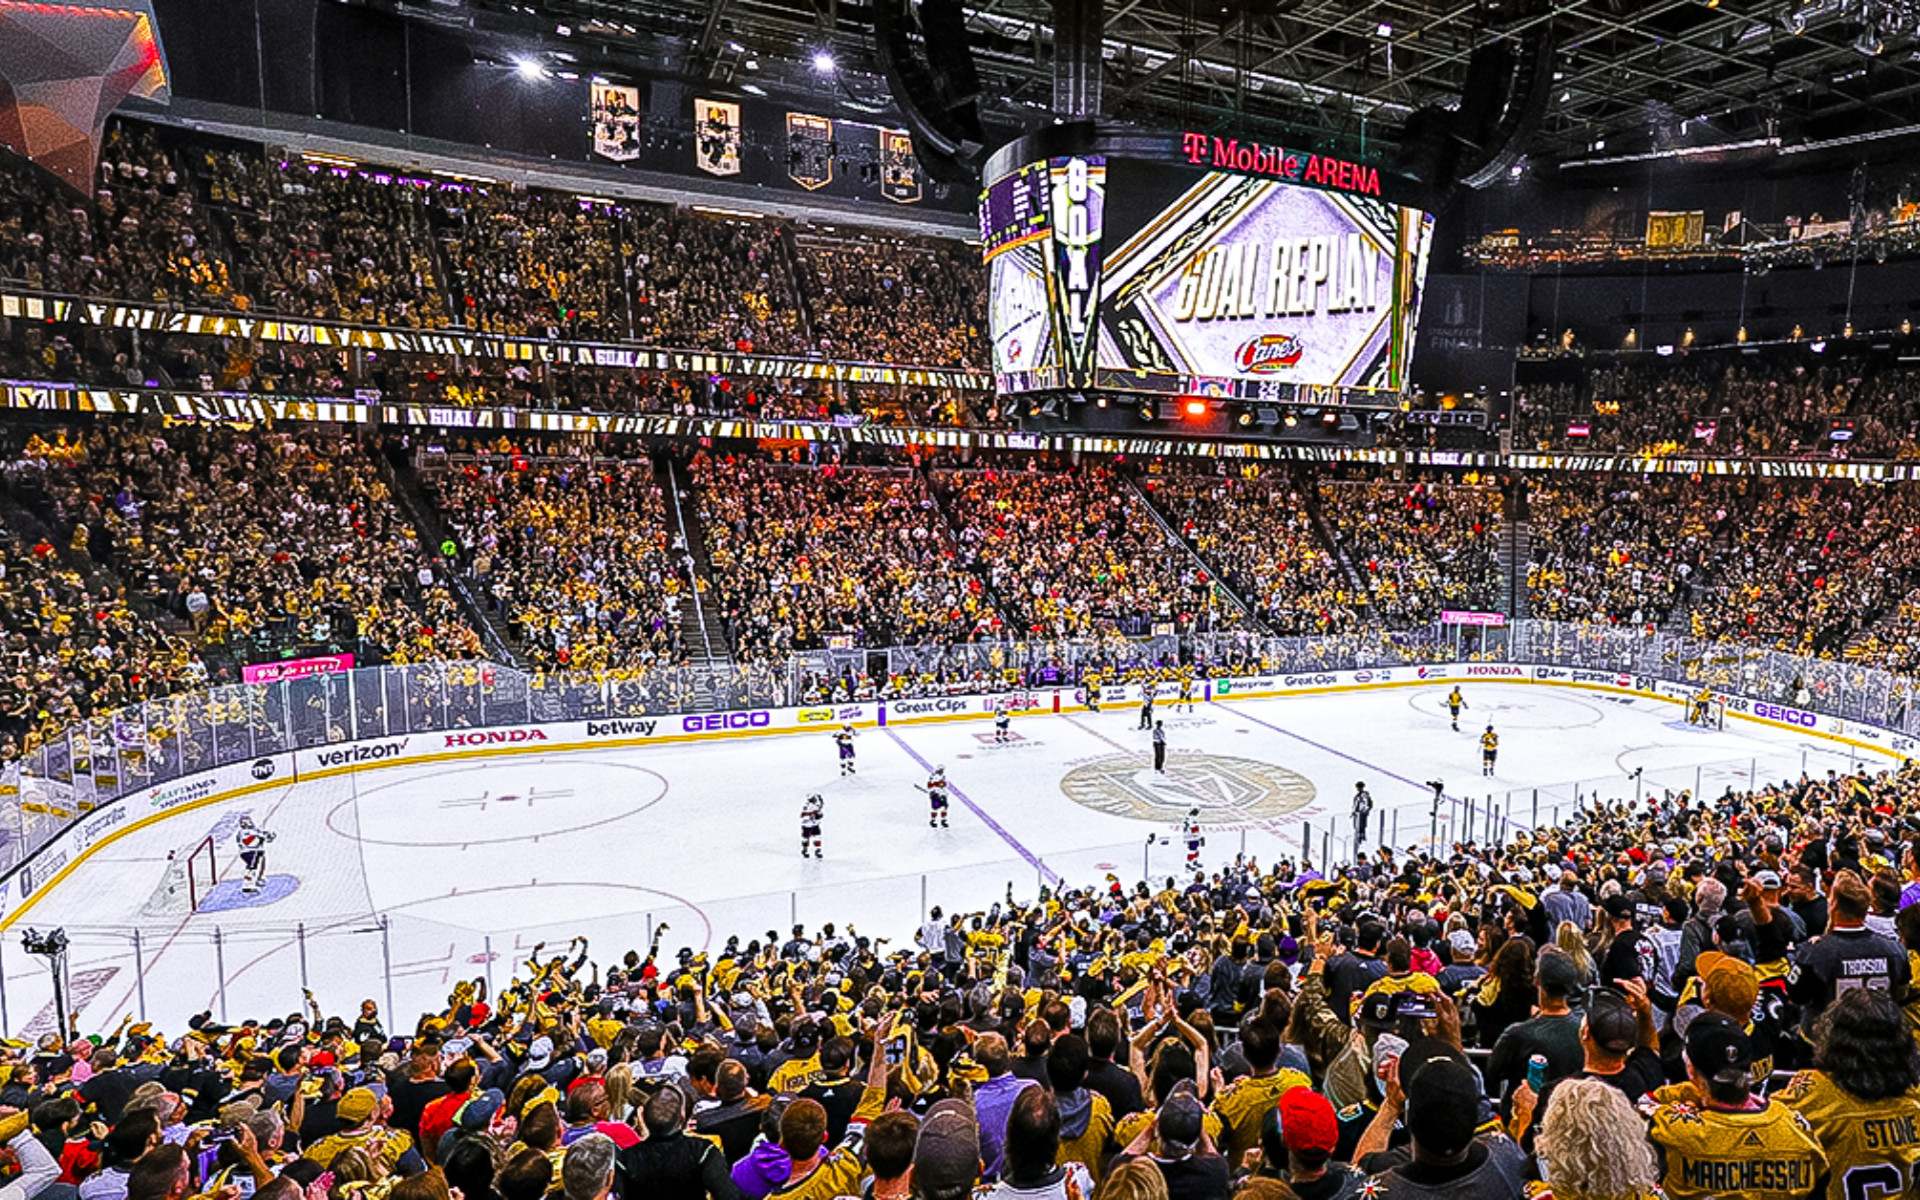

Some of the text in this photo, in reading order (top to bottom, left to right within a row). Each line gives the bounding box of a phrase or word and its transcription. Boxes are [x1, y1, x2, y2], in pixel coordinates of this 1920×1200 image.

[1212, 136, 1299, 178] Mobile
[1304, 153, 1382, 196] ARENA
[1067, 157, 1089, 333] GOAL
[1174, 232, 1380, 322] GOAL REPLAY
[429, 408, 474, 428] GOAL
[894, 701, 935, 714] Great
[936, 697, 968, 713] Clips
[1753, 702, 1817, 727] GEICO
[586, 719, 658, 737] betway
[682, 711, 771, 733] GEICO
[444, 728, 548, 748] HONDA
[317, 742, 400, 767] verizon
